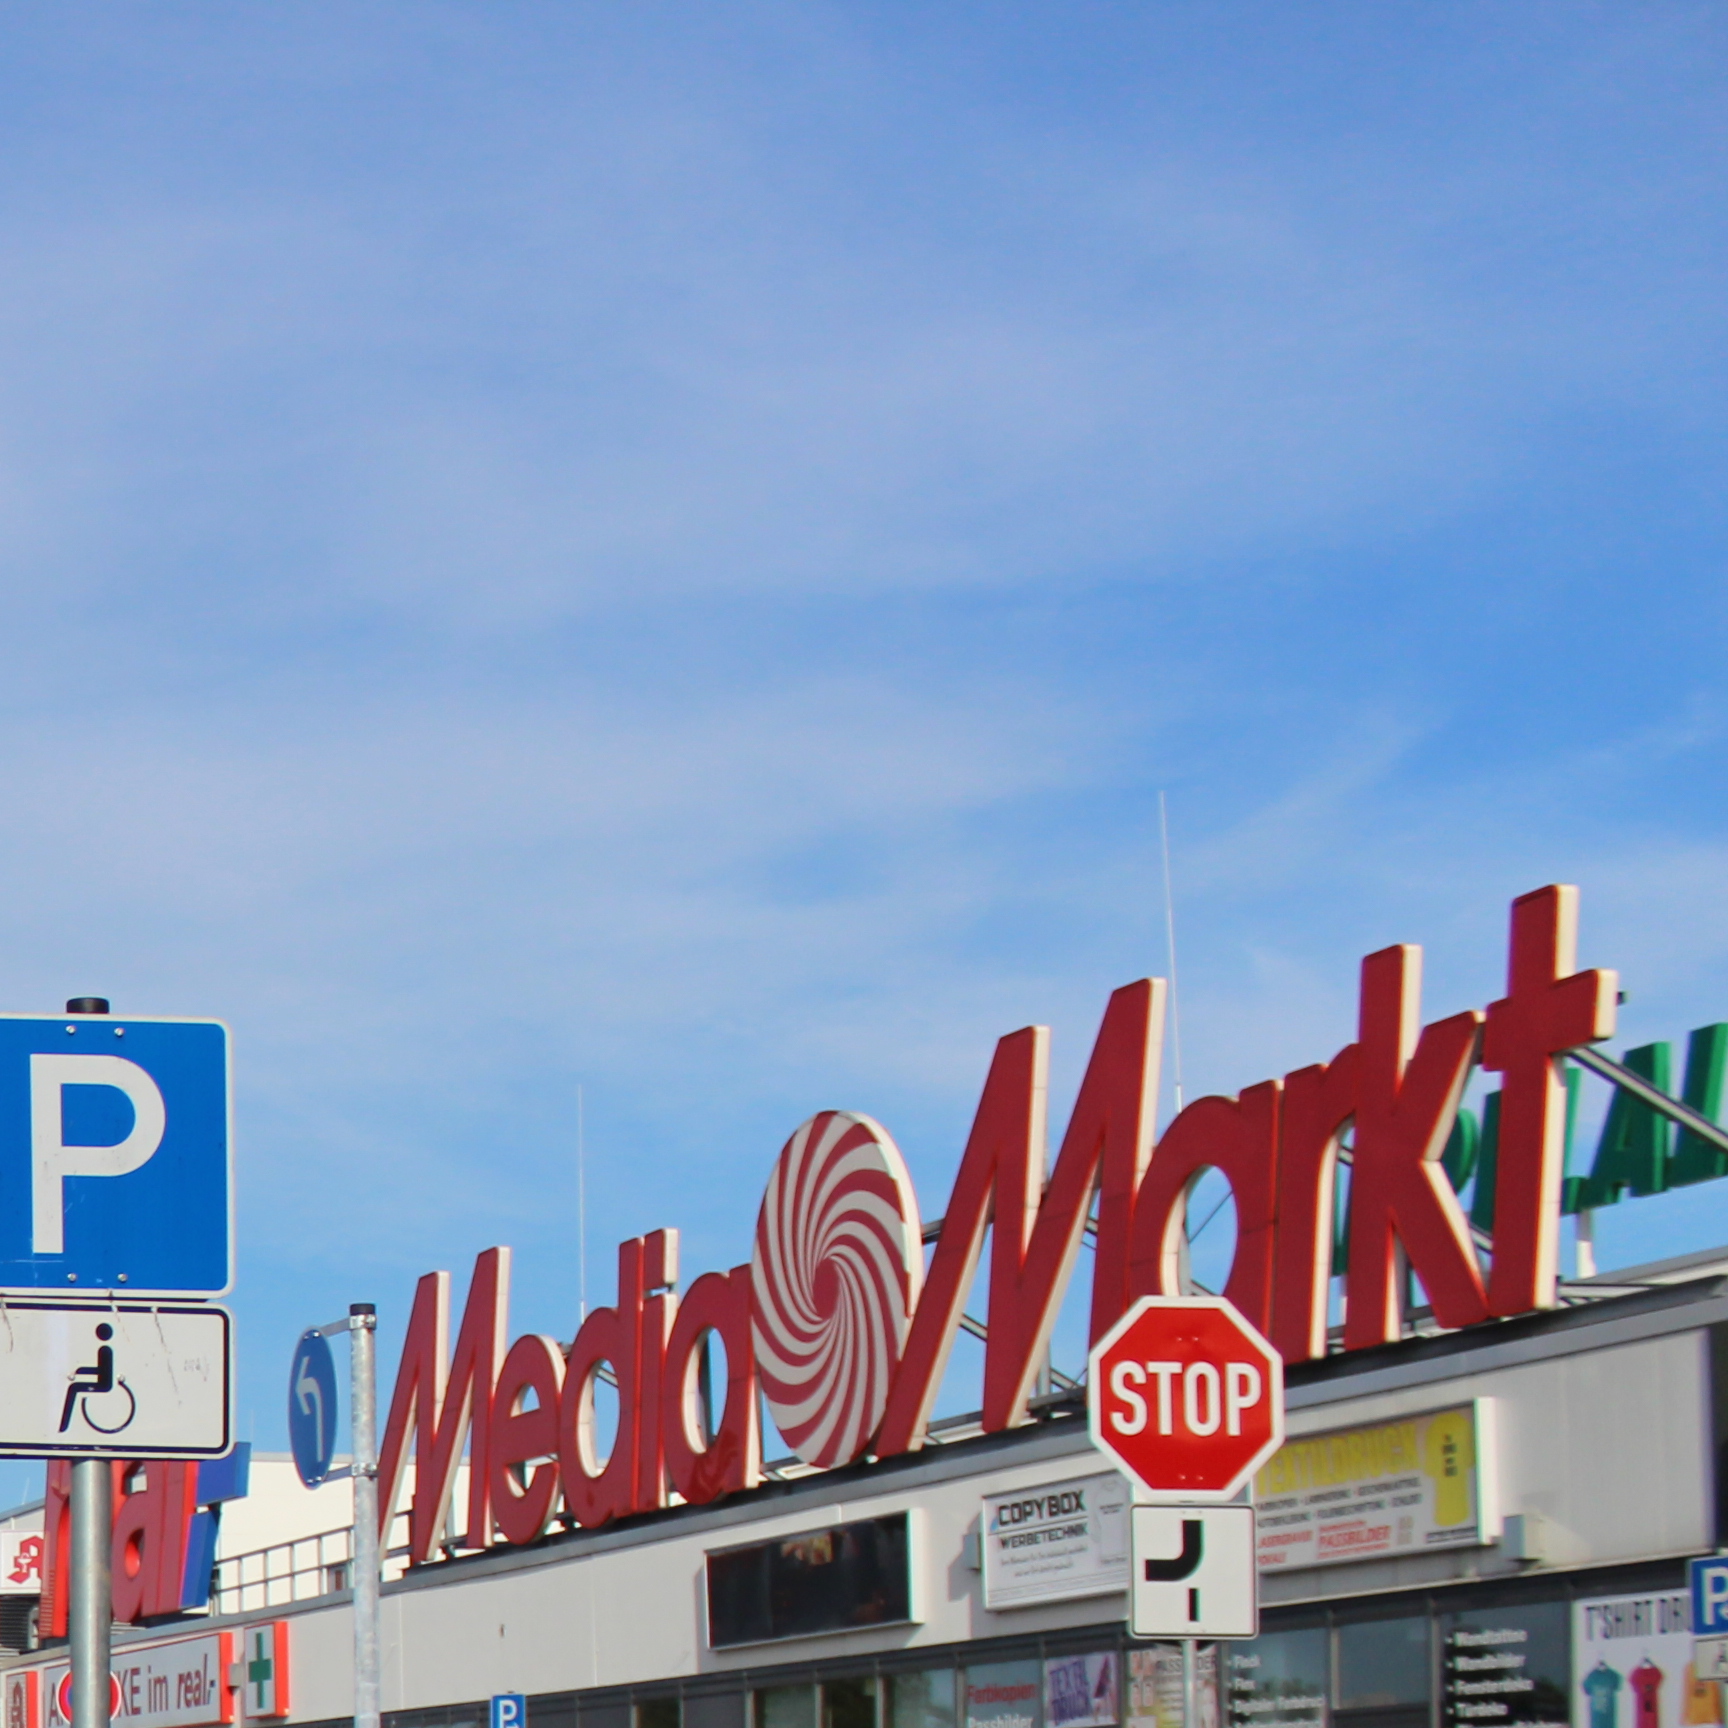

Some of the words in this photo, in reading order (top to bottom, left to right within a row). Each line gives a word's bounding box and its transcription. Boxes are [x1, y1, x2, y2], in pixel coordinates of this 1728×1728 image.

[29, 1053, 166, 1254] P
[380, 1228, 760, 1566] Media
[874, 884, 1618, 1458] Markt
[1110, 1359, 1262, 1437] STOP
[998, 1489, 1086, 1527] COPYBOX
[999, 1522, 1089, 1549] WERBETECHNIK
[1702, 1566, 1728, 1626] P
[147, 1665, 170, 1715] im
